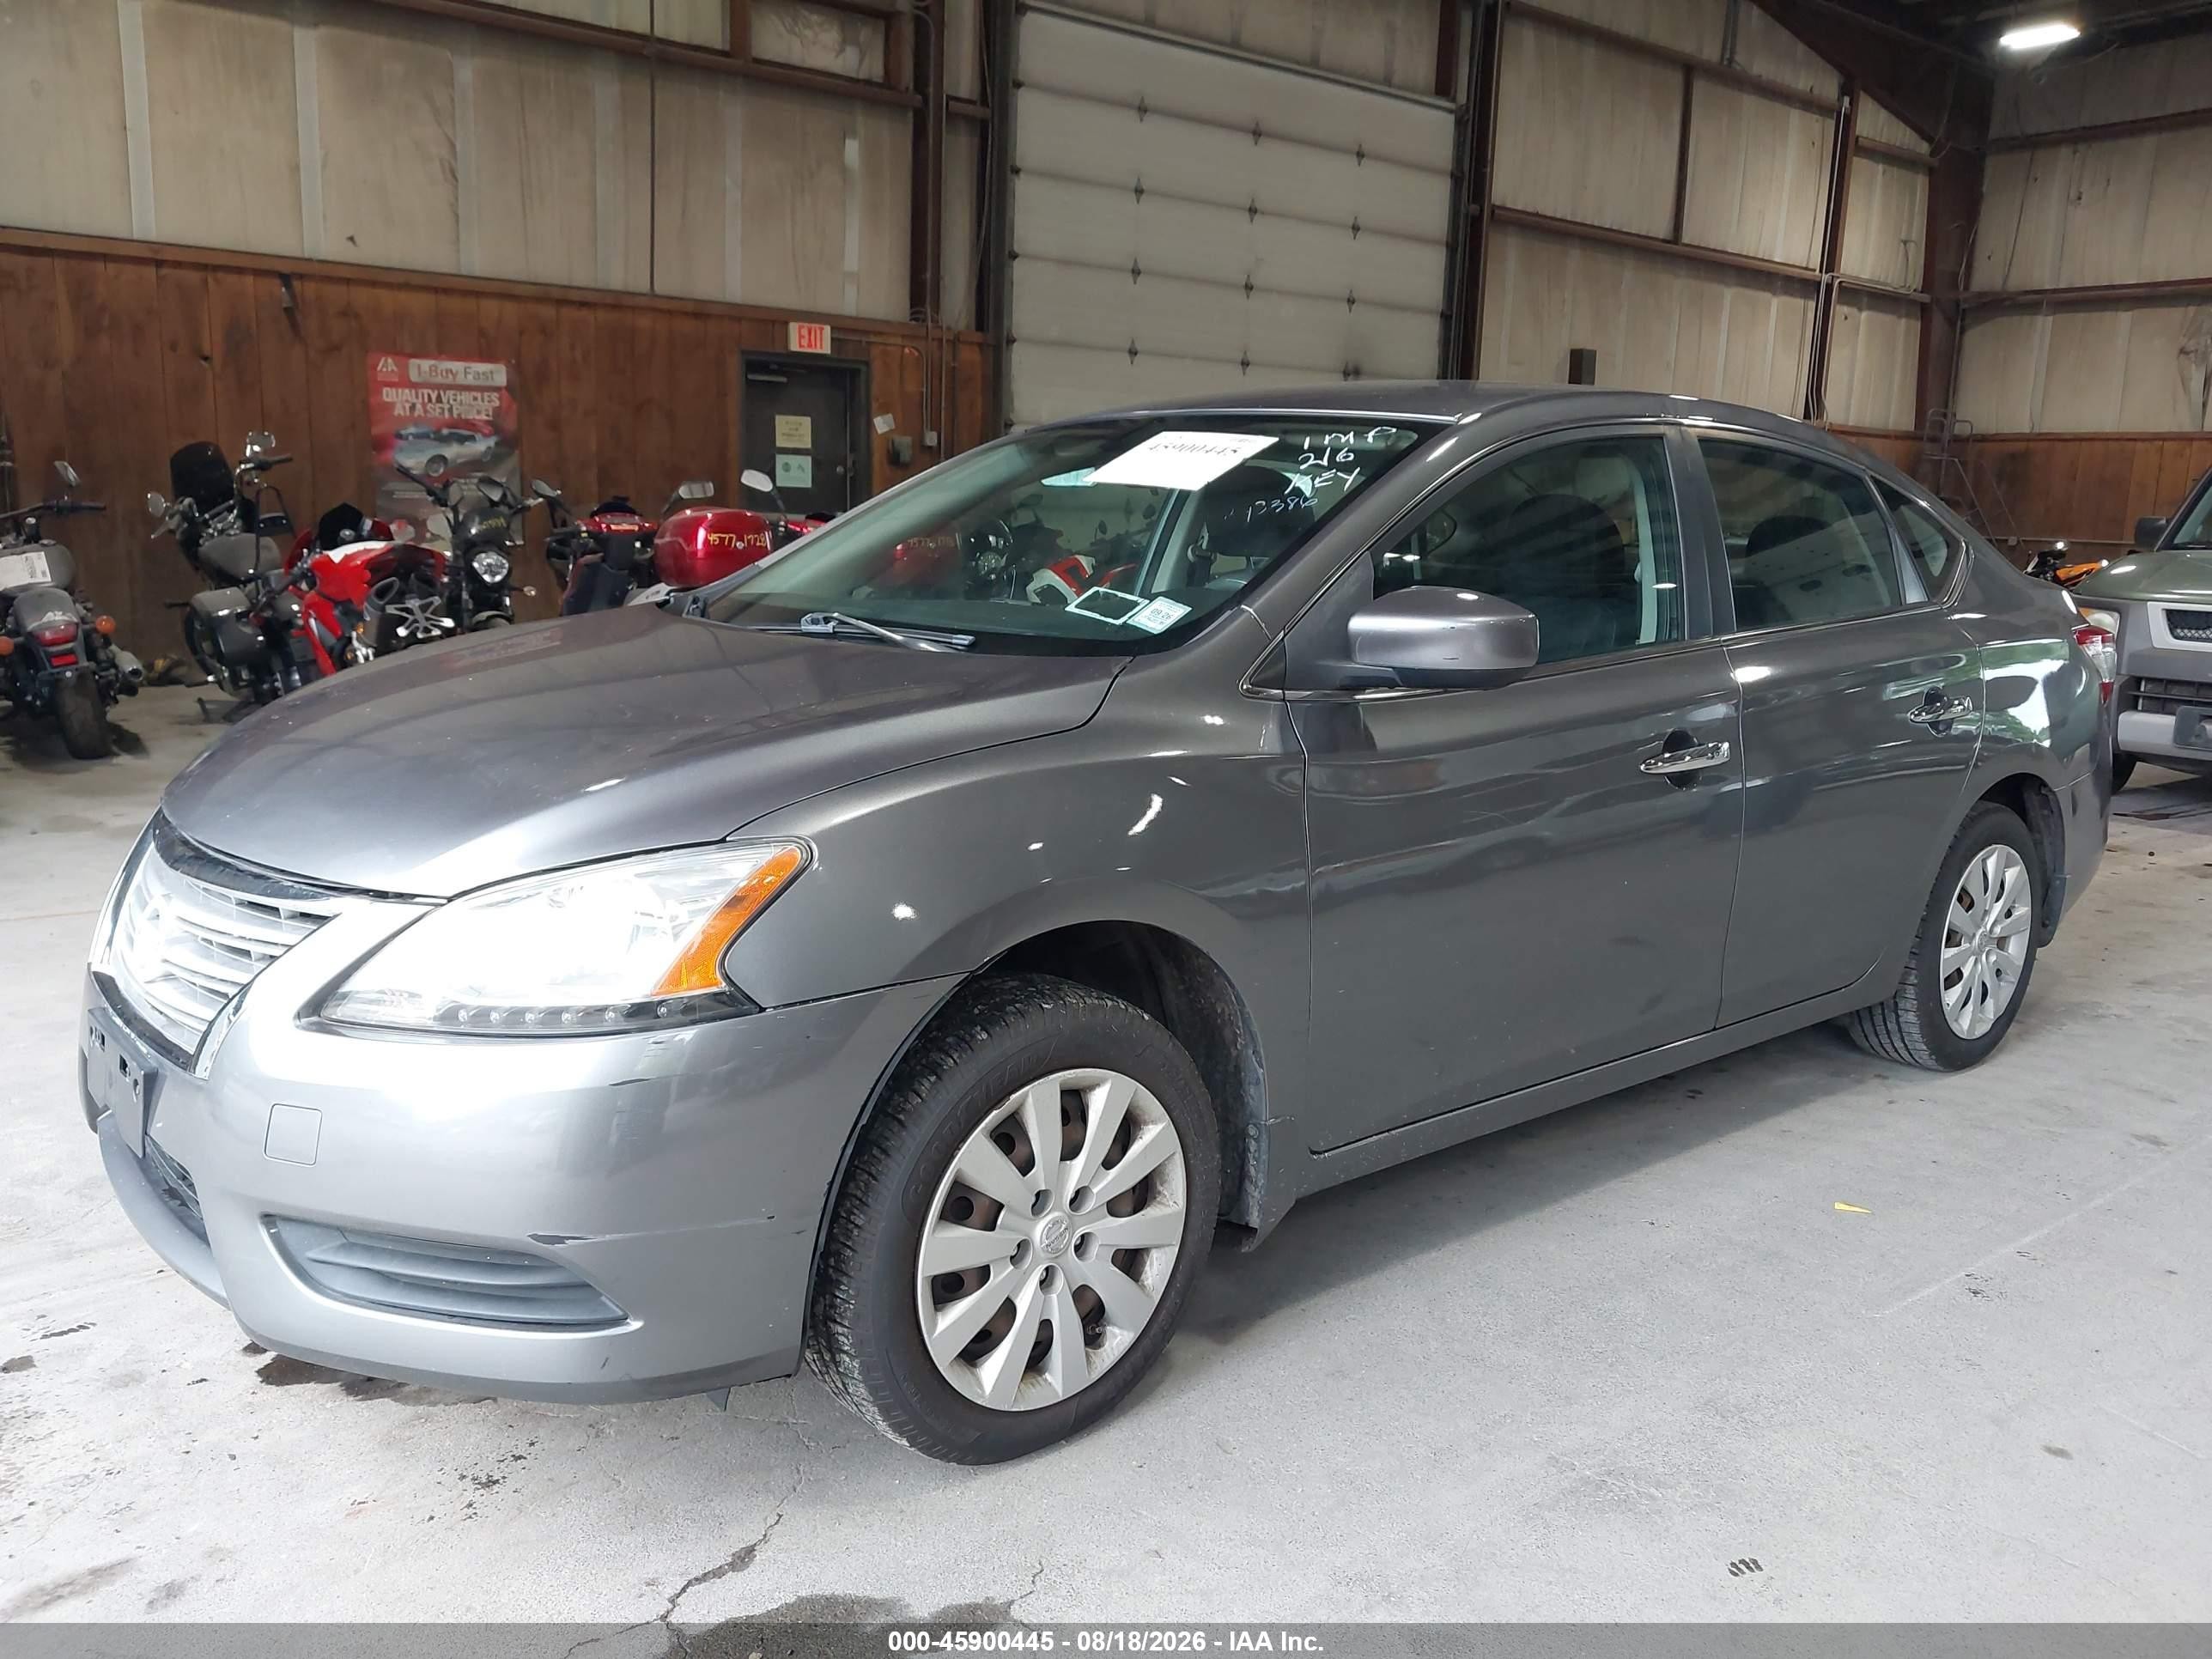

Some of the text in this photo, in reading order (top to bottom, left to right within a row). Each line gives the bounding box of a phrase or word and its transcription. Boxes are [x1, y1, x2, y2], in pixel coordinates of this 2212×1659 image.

[797, 325, 825, 350] EXIT
[416, 363, 459, 382] I-Buy
[464, 367, 495, 382] Fast
[382, 388, 500, 407] QUALITY VEHICLES
[394, 403, 413, 416] AT
[414, 404, 425, 417] A
[428, 404, 452, 419] SET
[1298, 447, 1355, 470] 216
[707, 533, 737, 549] 4577
